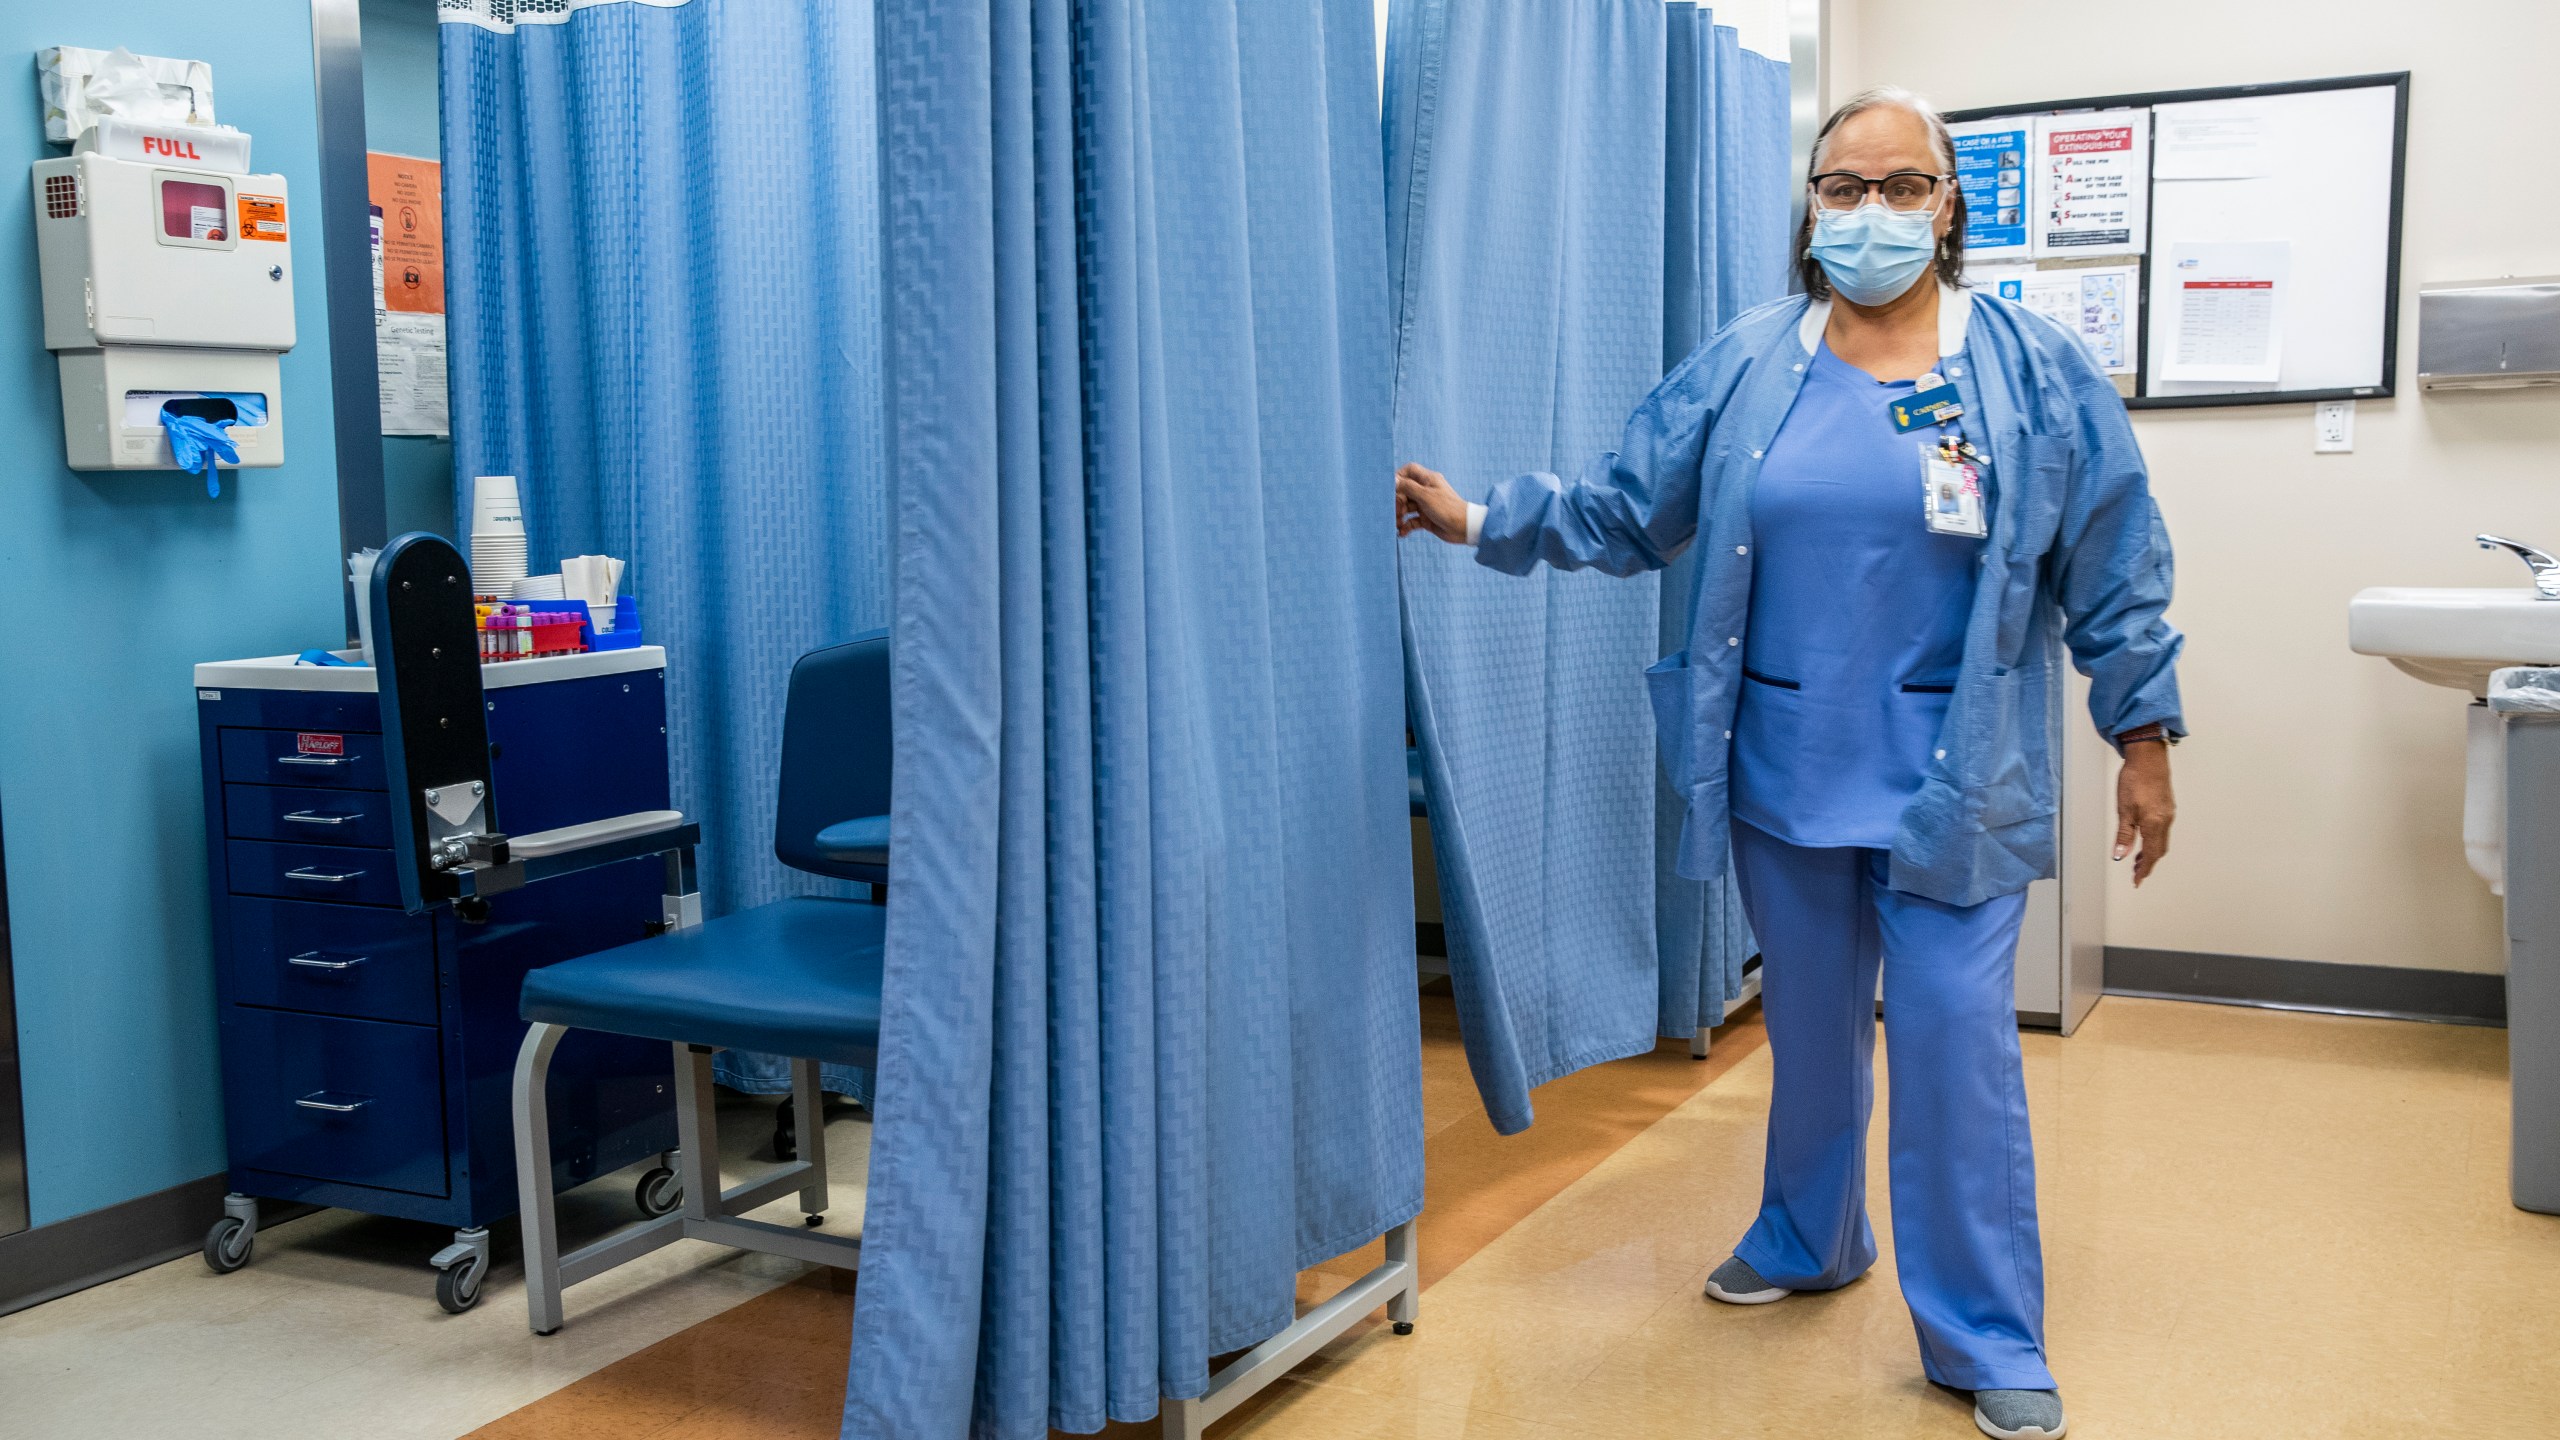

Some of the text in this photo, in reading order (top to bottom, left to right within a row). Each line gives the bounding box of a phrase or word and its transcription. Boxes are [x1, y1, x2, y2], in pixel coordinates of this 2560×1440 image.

[1962, 138, 1979, 147] CASE
[1980, 137, 1990, 145] OF
[1998, 135, 2013, 144] FIRE
[2053, 130, 2128, 143] OPERATING YOUR
[143, 136, 201, 160] FULL
[2058, 140, 2122, 152] EXTINGUISHER
[390, 326, 434, 335] Genetic Testing
